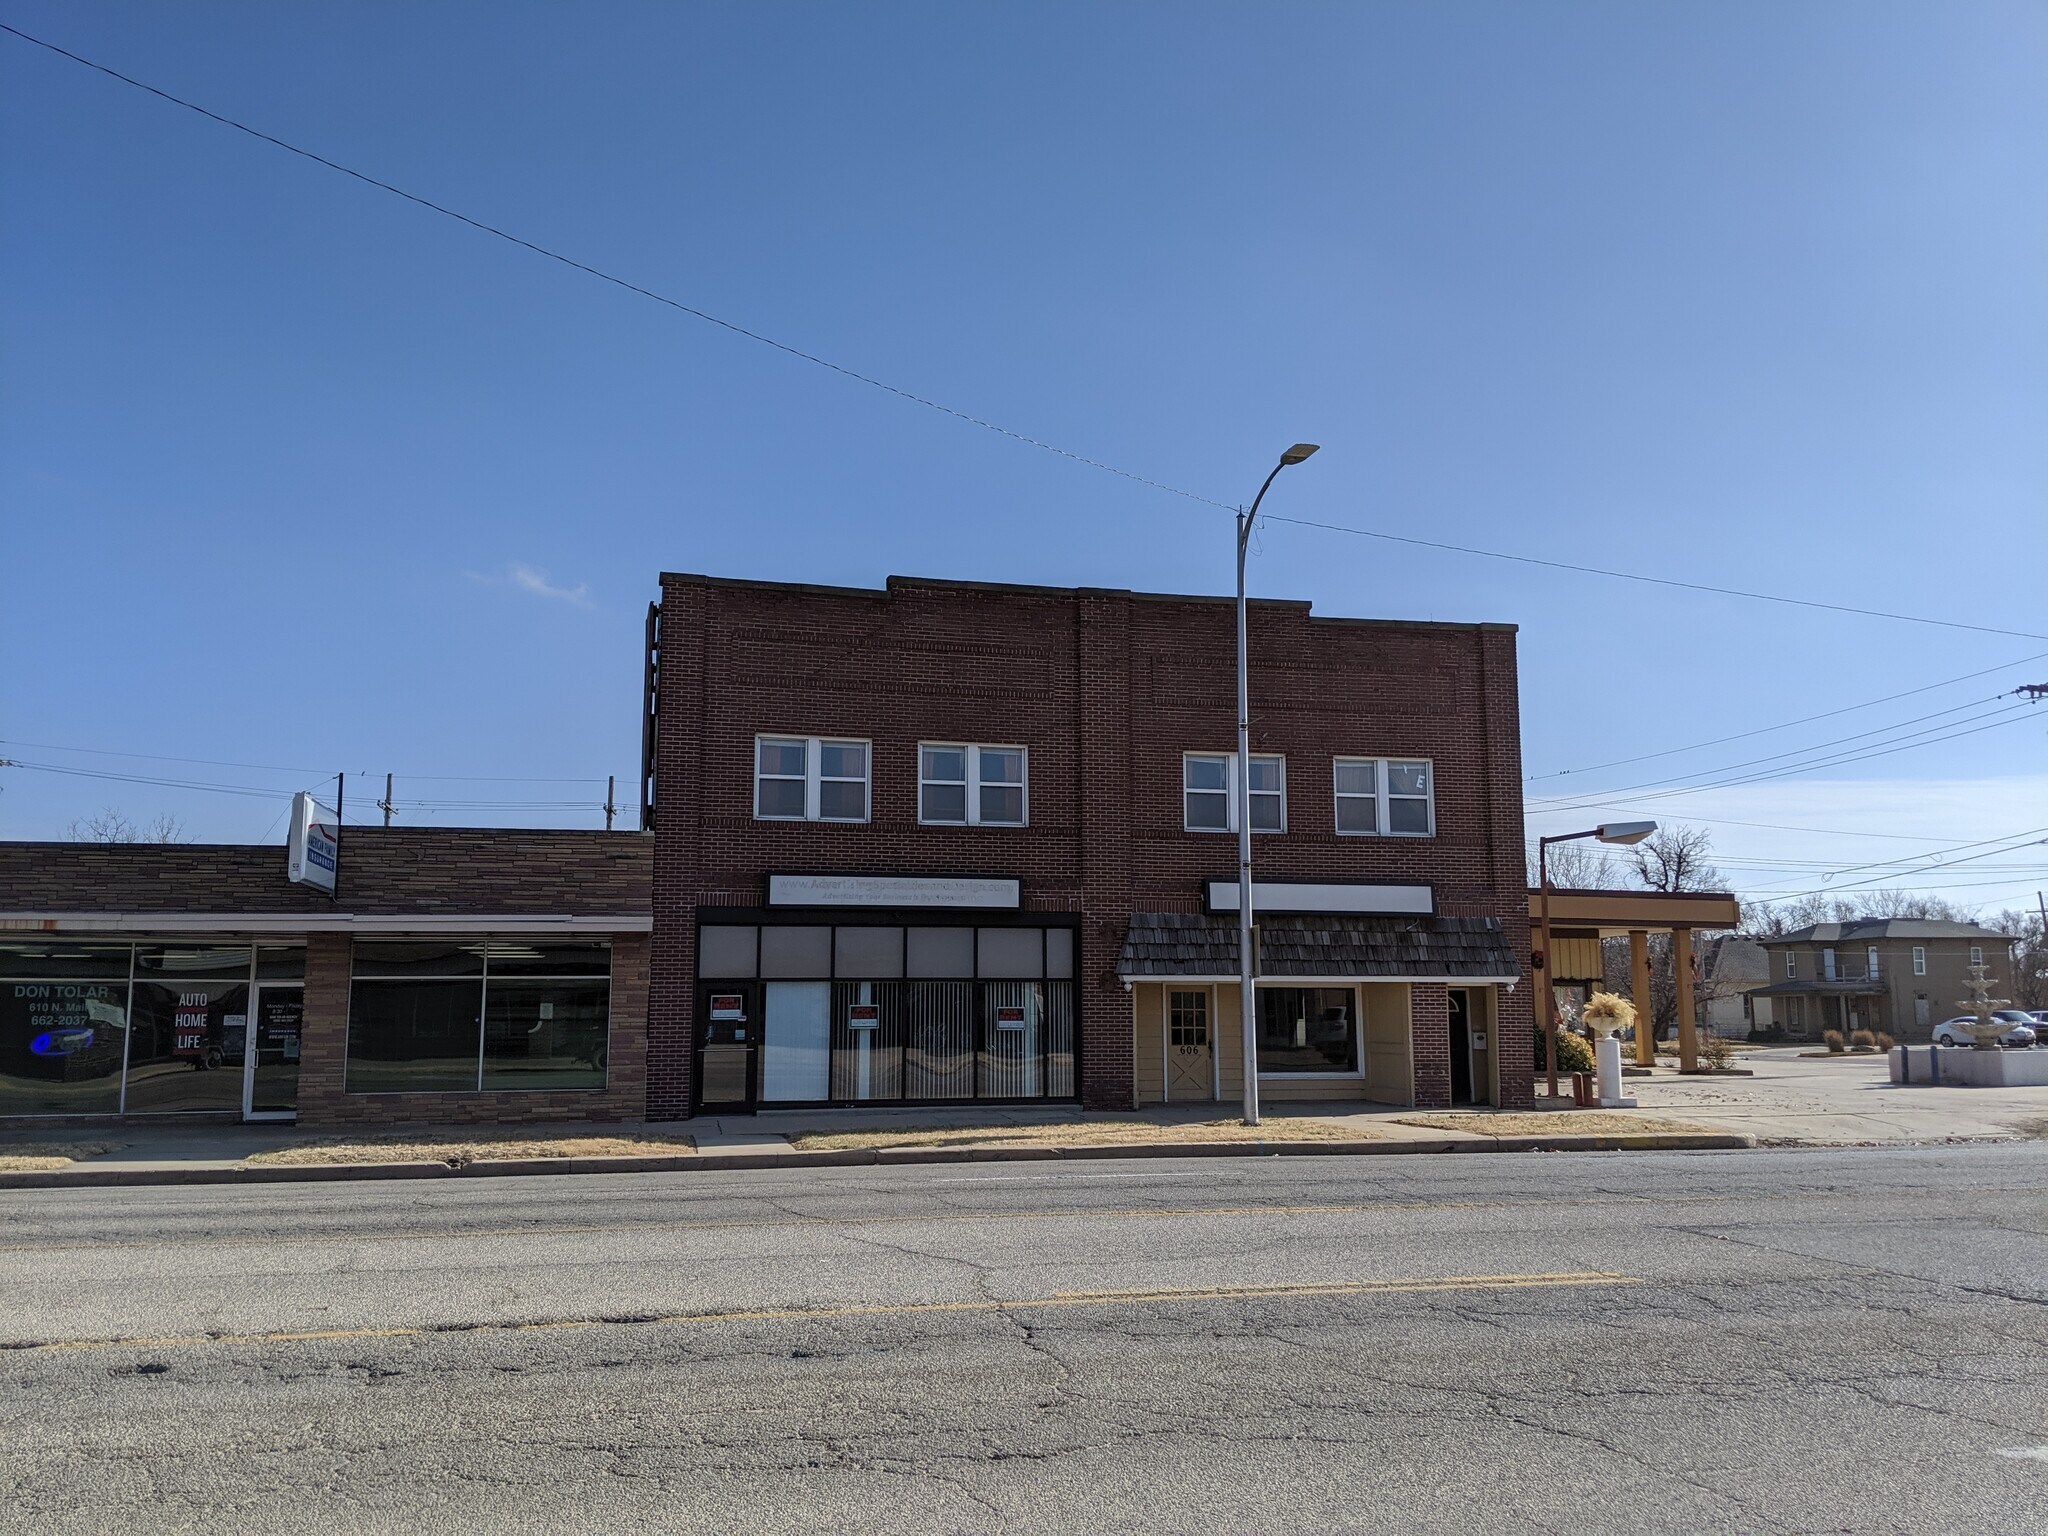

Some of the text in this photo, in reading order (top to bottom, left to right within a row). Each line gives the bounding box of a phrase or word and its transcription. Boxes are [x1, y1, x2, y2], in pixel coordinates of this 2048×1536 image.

[308, 850, 333, 870] INSURANCE
[14, 986, 109, 998] DON TOLAR
[179, 993, 208, 1007] AUTO
[29, 1003, 48, 1012] 610
[51, 1003, 63, 1012] N.
[31, 1015, 88, 1025] 662-2037
[175, 1013, 208, 1027] HOME
[177, 1035, 201, 1049] LIFE
[1180, 1045, 1199, 1055] 606
